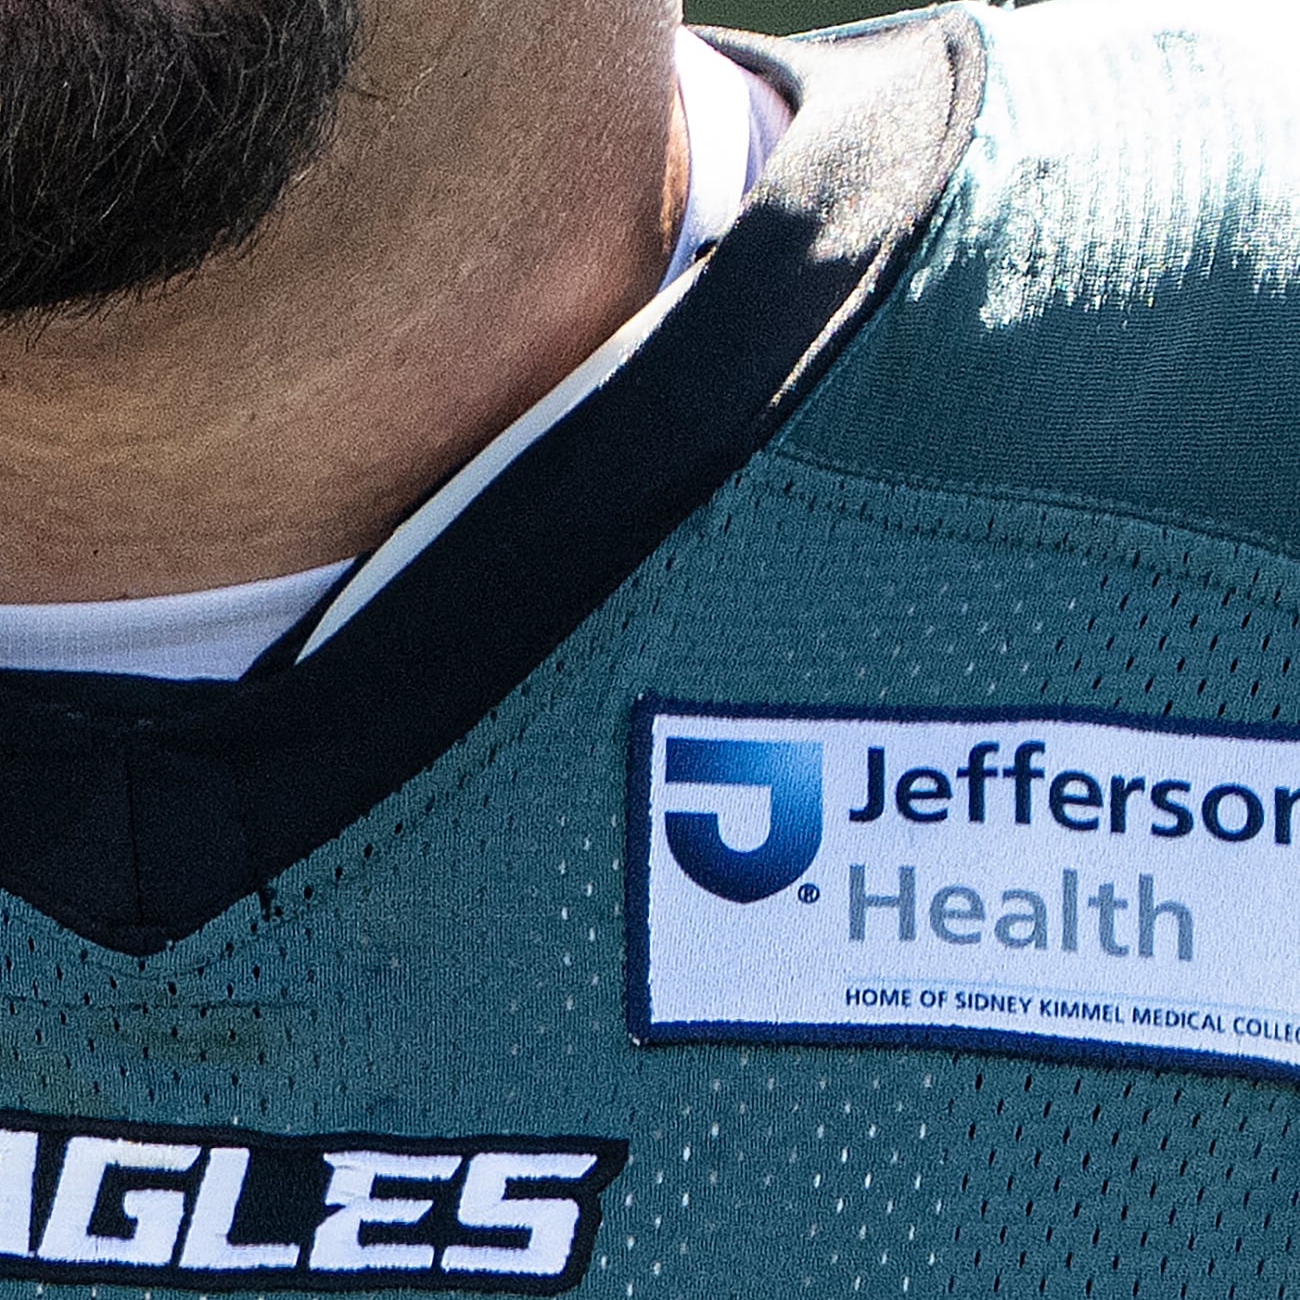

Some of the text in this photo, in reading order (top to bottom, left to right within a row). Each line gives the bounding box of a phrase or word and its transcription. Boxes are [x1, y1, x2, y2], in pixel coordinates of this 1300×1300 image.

[847, 863, 1194, 963] Health
[845, 987, 912, 1008] HOME
[919, 989, 948, 1009] OF
[954, 990, 1032, 1014] SIDNEY
[1039, 997, 1125, 1024] KIMMEL
[1132, 1006, 1226, 1034] MEDICAL
